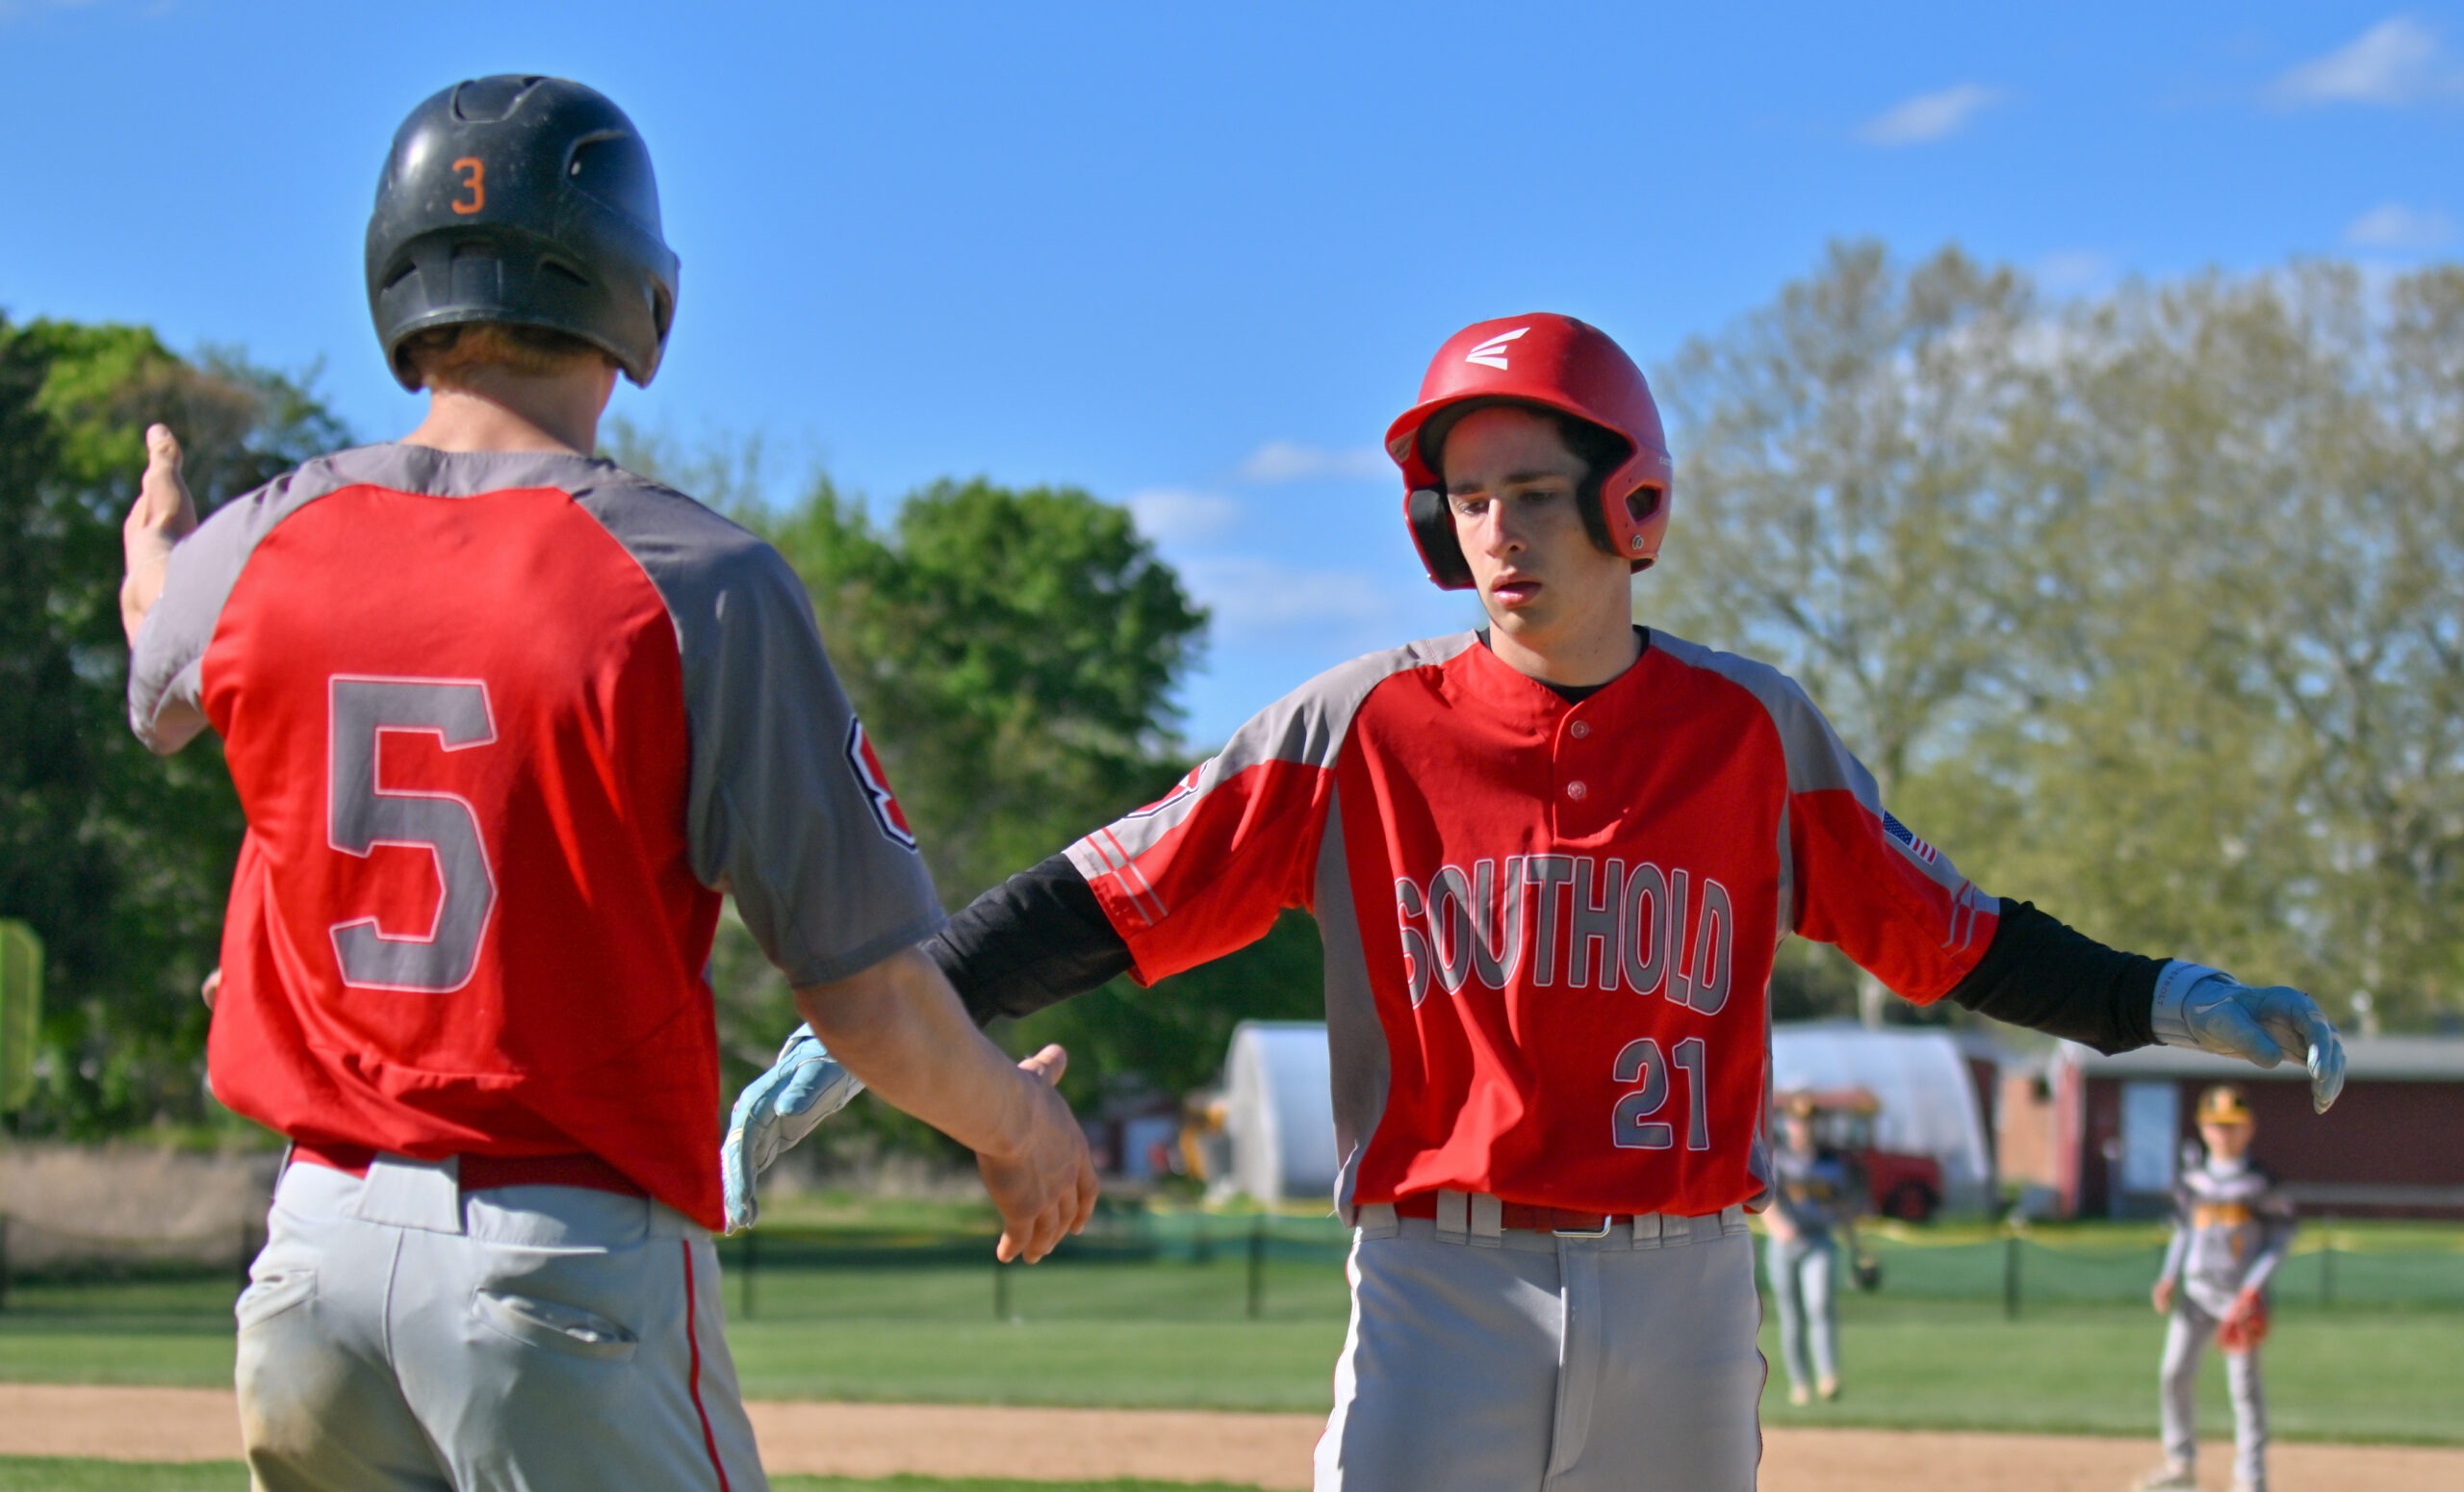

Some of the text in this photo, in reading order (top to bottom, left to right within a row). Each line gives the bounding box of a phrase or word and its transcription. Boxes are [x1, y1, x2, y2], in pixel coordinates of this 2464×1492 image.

[451, 156, 485, 215] 3
[327, 674, 499, 993] 5
[1395, 853, 1733, 1016] SOUTHOLD
[1611, 1037, 1710, 1150] 21
